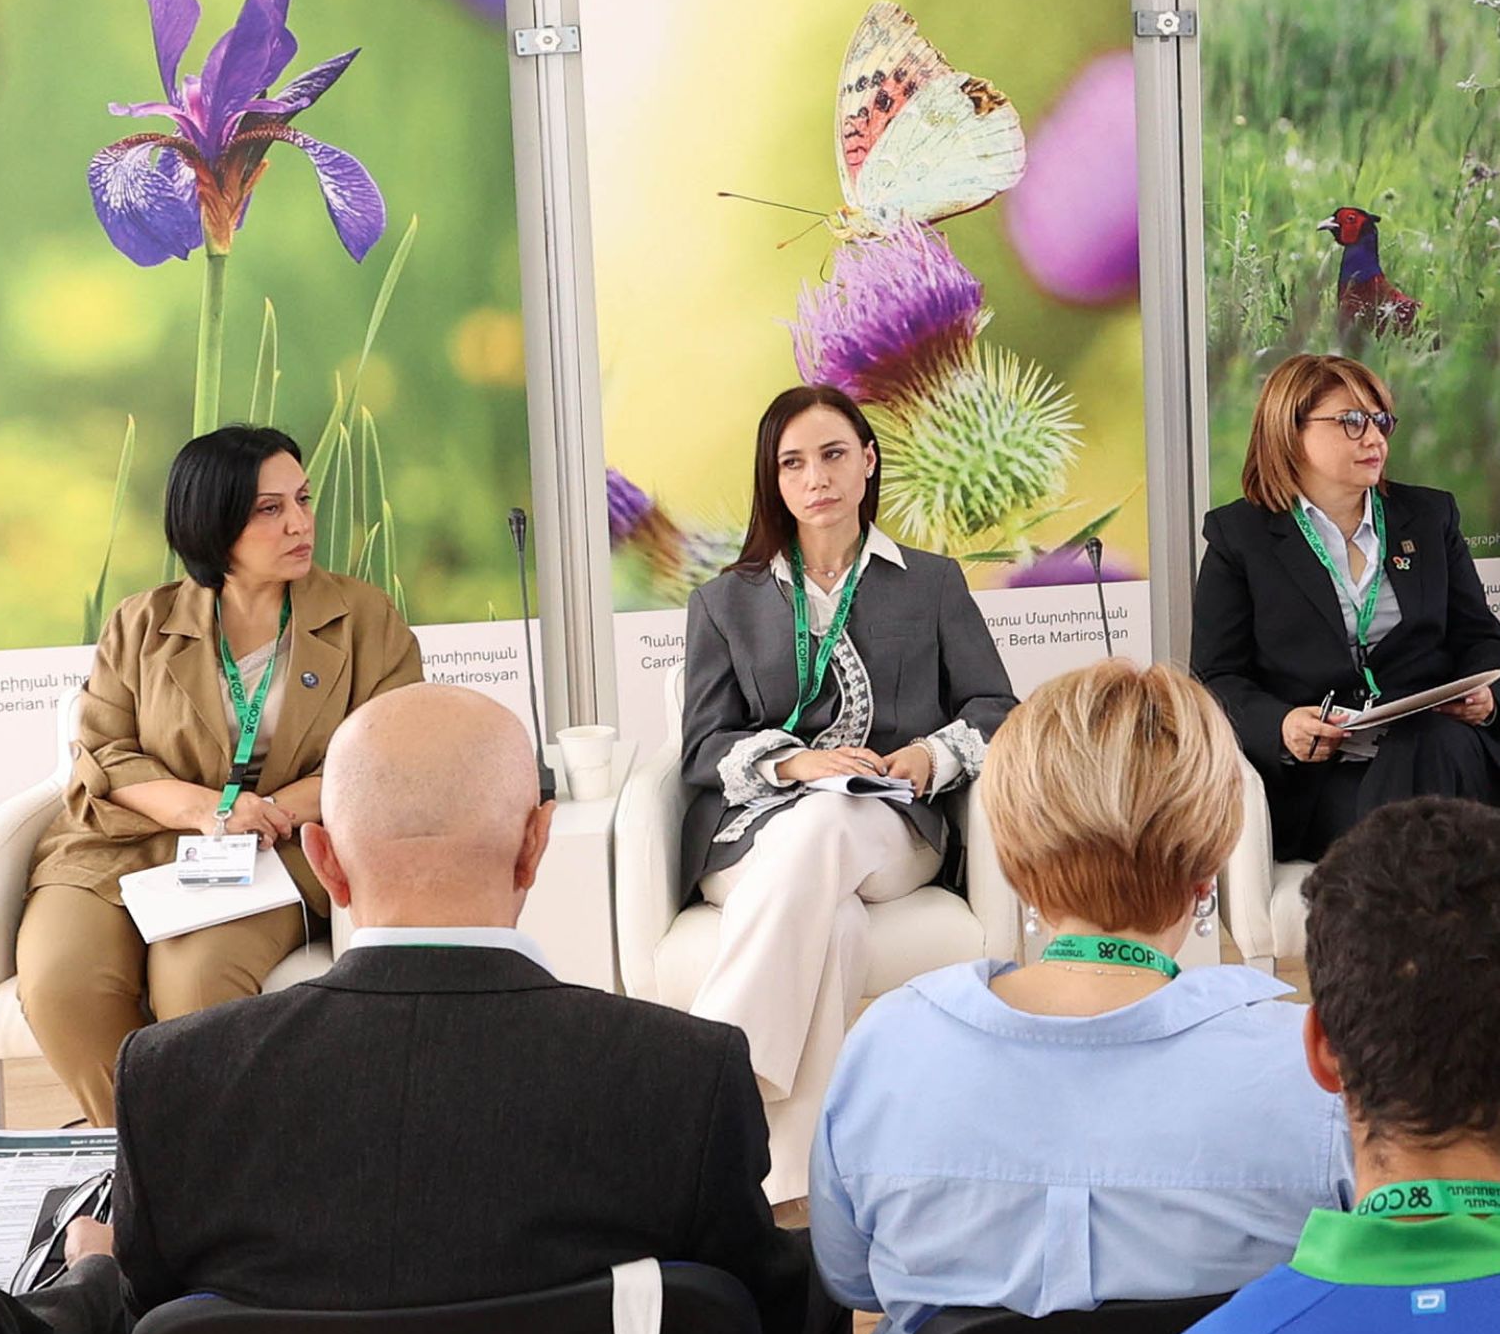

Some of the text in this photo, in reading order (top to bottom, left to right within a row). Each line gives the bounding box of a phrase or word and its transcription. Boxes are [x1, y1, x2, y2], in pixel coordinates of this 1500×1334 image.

[1025, 606, 1128, 626] Մարտիրոսան
[1009, 633, 1045, 646] Berta
[1050, 628, 1129, 644] Martirosan
[432, 670, 519, 684] Martirosyan
